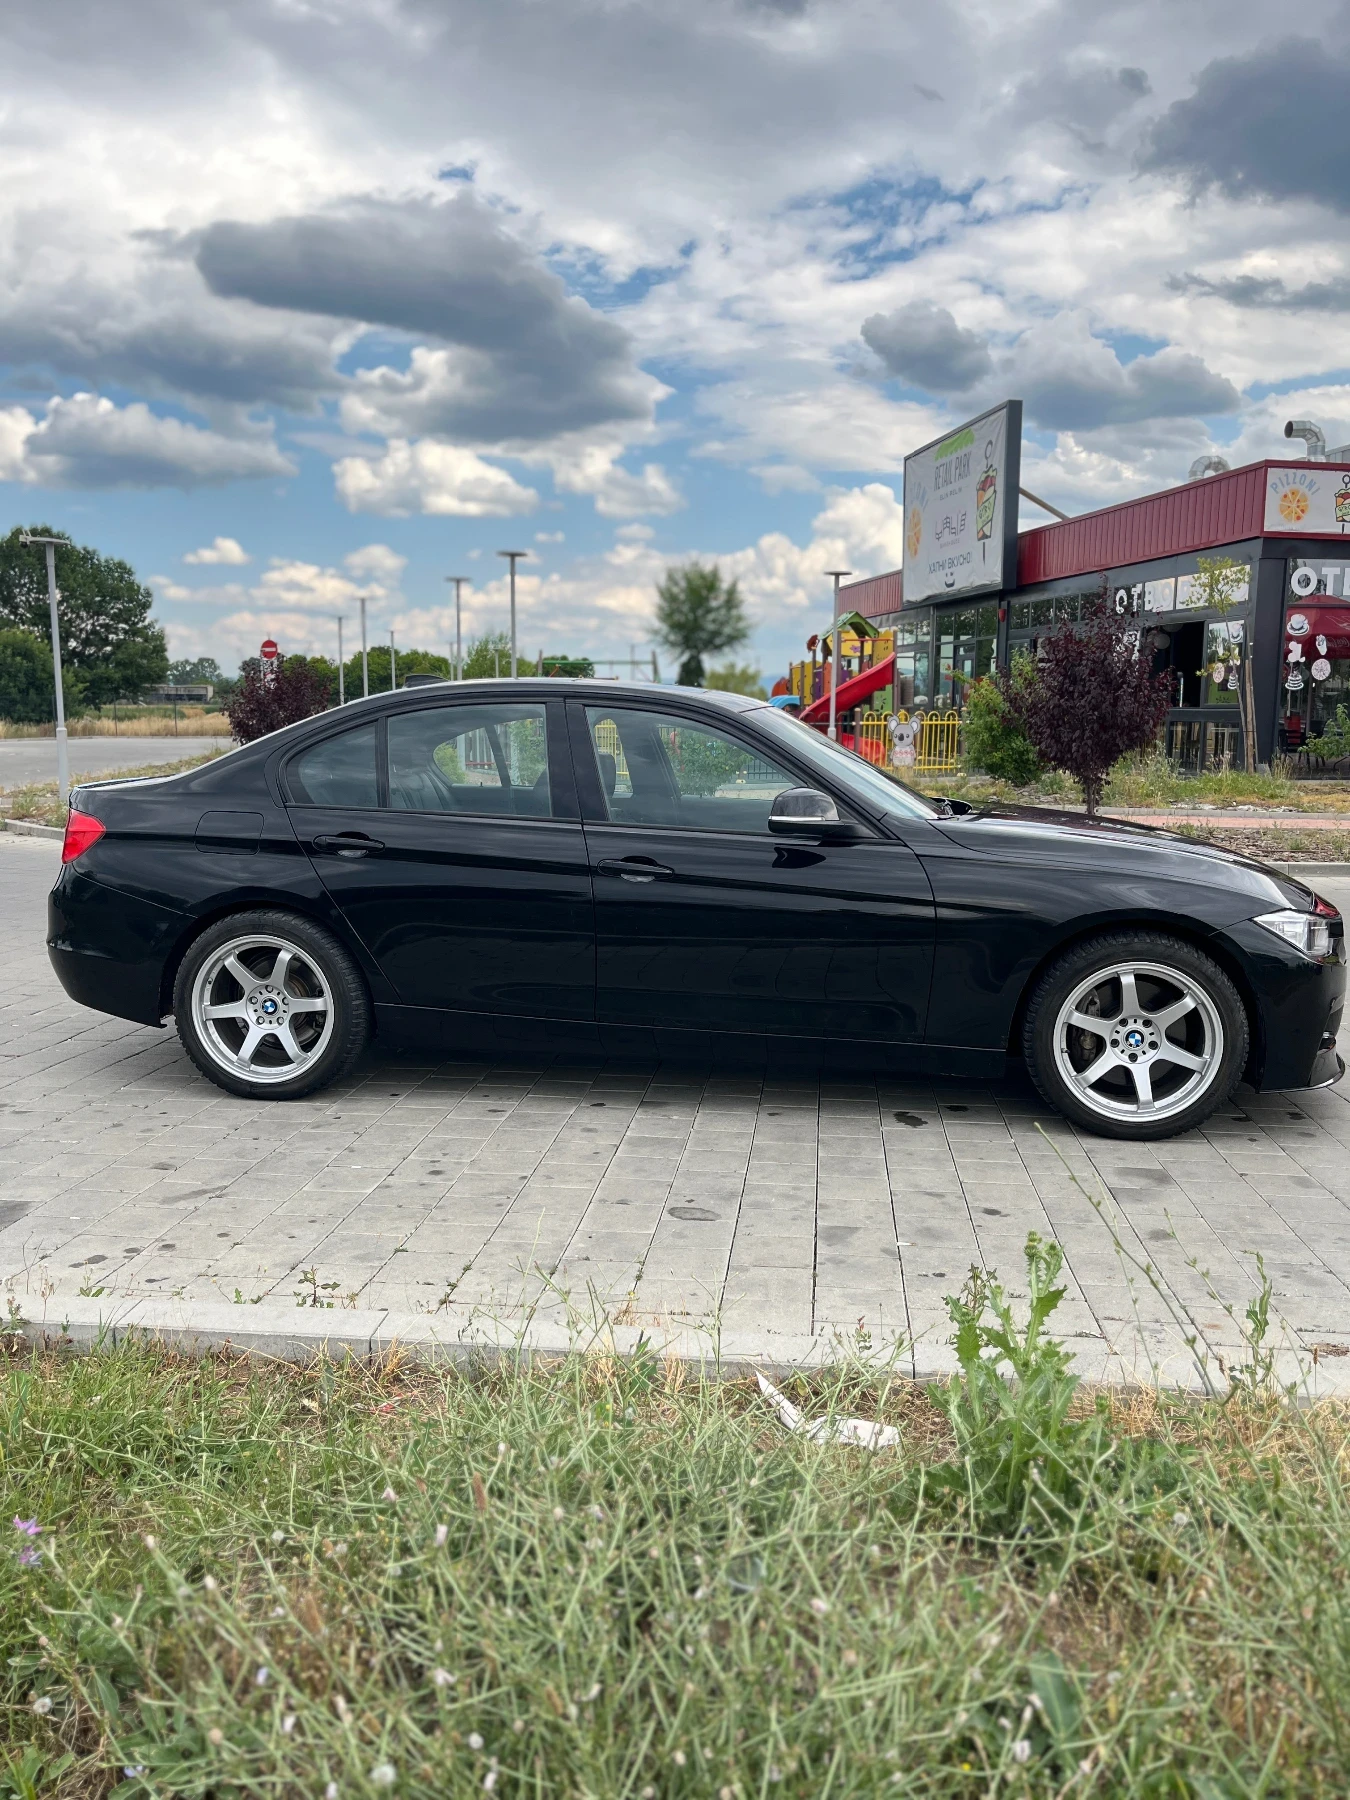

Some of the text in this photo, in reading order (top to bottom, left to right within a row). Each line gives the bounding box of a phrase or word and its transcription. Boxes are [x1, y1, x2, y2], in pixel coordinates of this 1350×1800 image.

[934, 450, 972, 491] RETAIL PARK
[1270, 472, 1320, 495] PIZZONI
